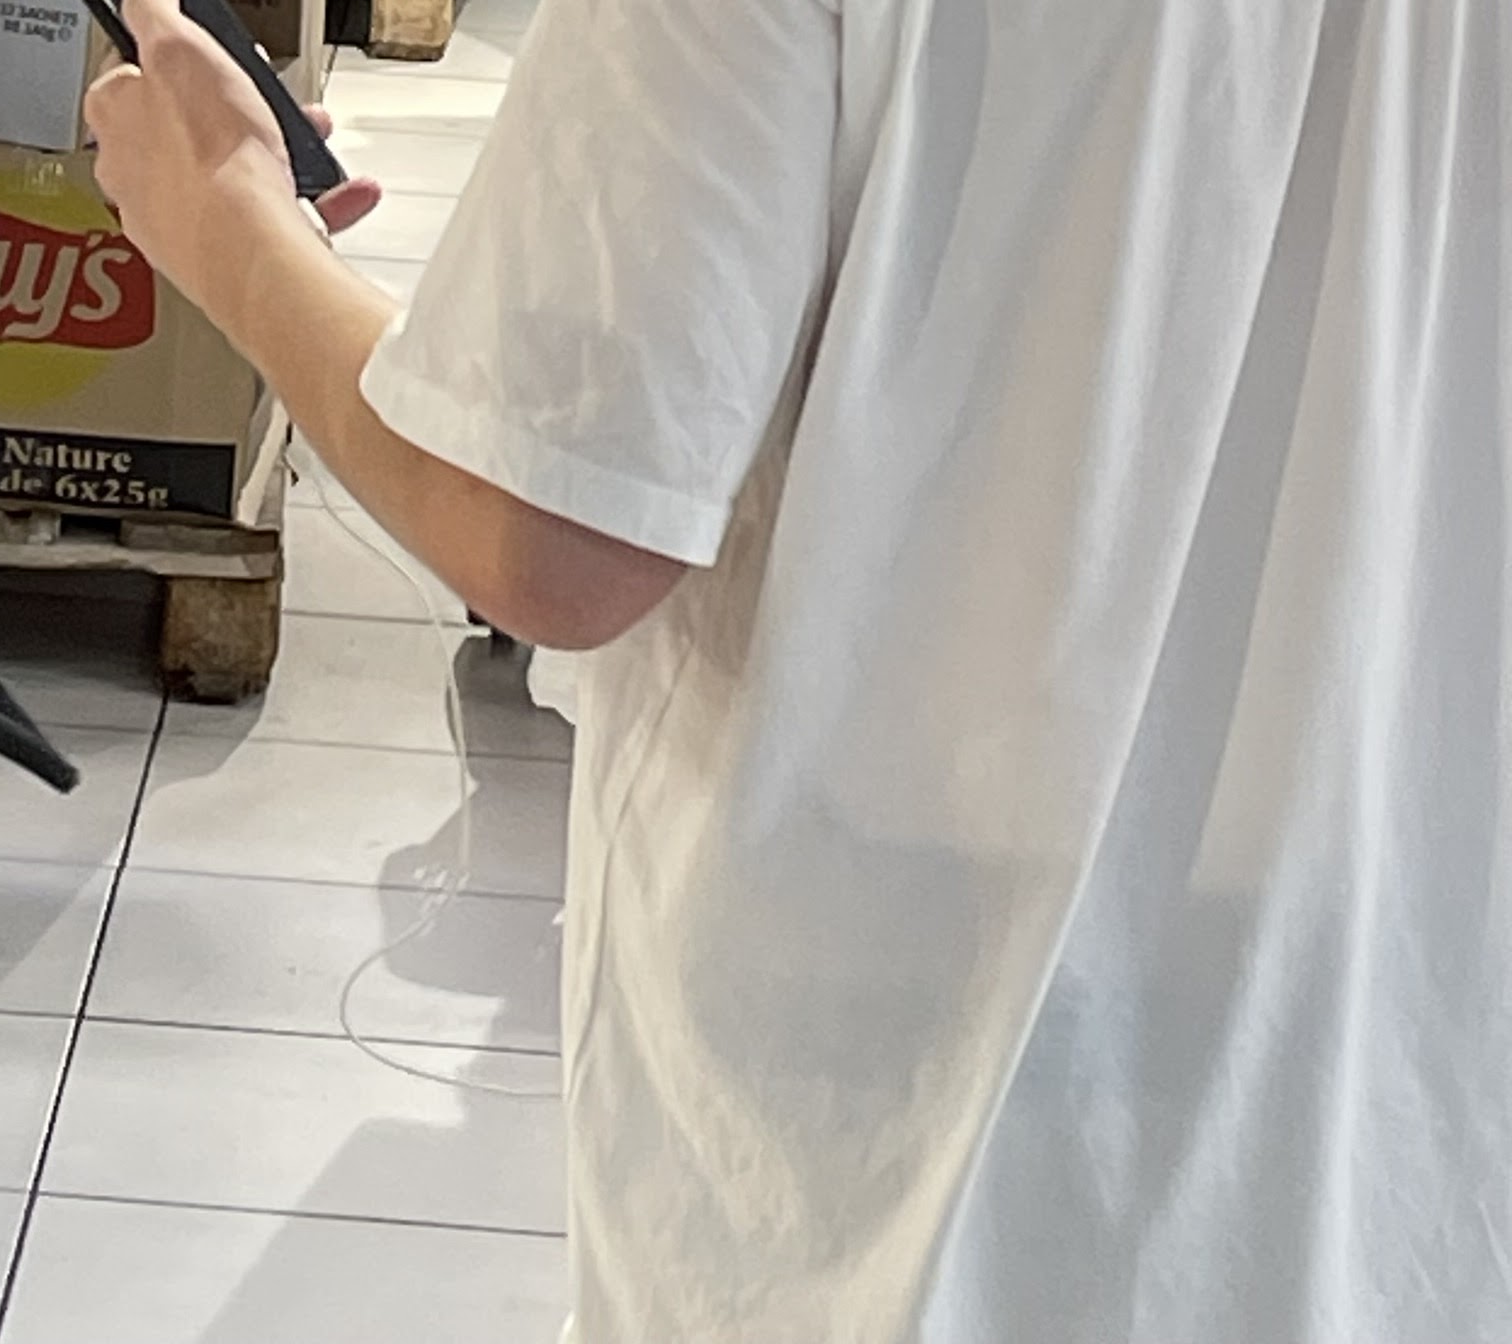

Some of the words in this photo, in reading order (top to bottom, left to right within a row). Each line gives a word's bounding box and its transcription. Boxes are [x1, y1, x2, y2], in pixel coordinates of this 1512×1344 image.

[3, 436, 133, 474] Nature
[0, 468, 43, 494] de
[55, 473, 169, 509] 6x25g
